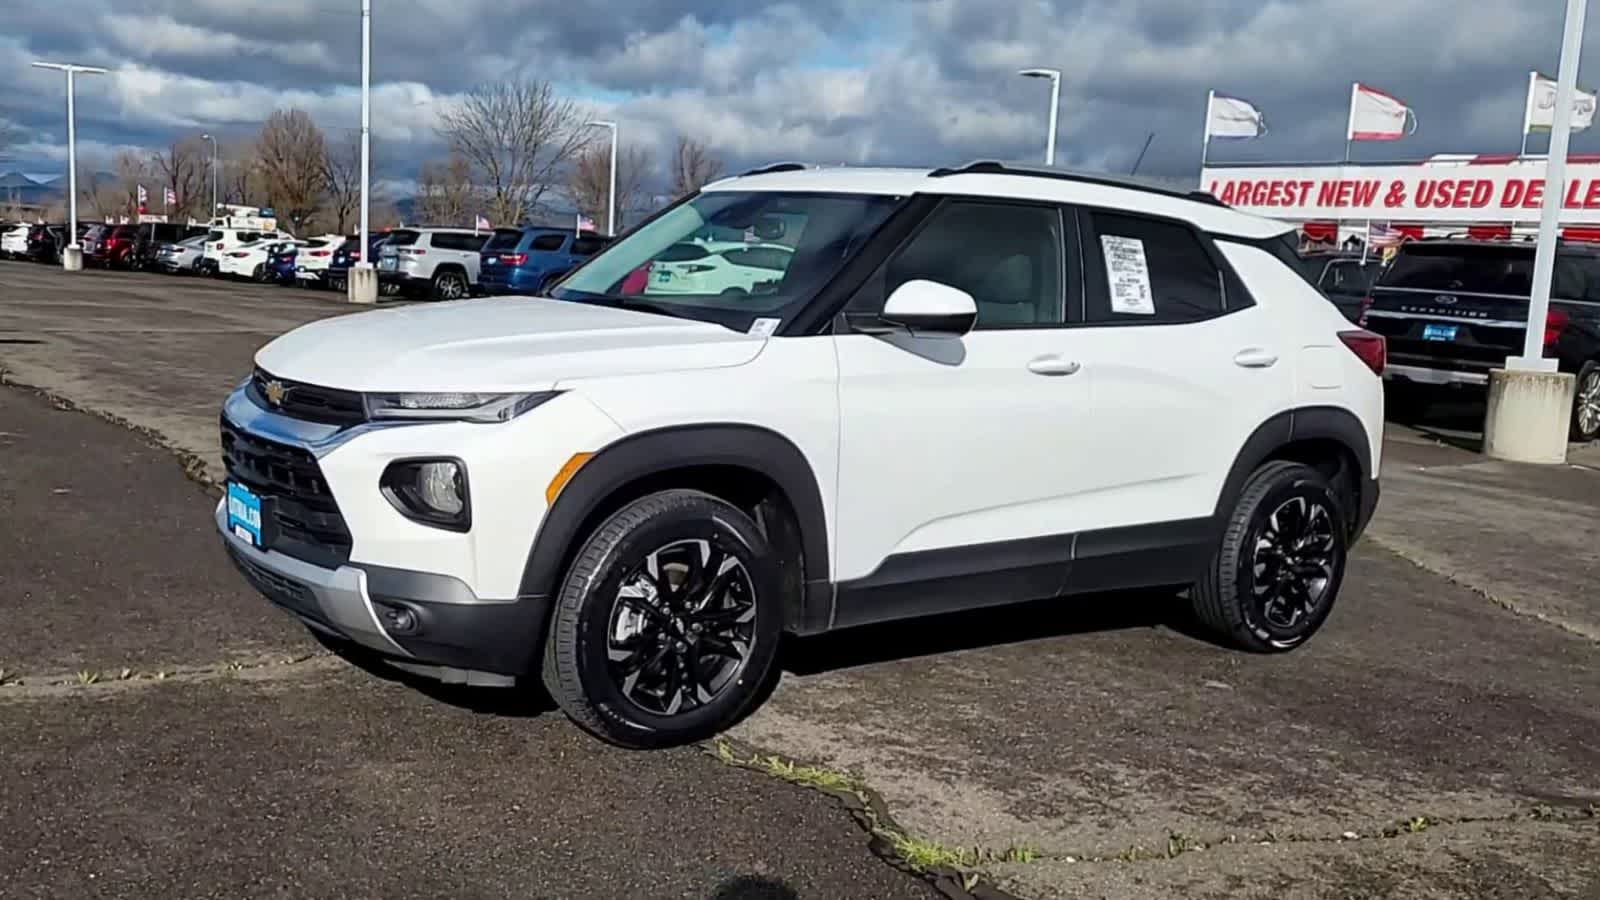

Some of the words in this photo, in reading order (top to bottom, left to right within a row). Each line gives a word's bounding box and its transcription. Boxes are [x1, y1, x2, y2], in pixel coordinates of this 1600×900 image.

[1316, 181, 1381, 207] NEW
[1384, 180, 1406, 208] &
[1414, 179, 1494, 208] USED
[1499, 179, 1600, 209] DELE
